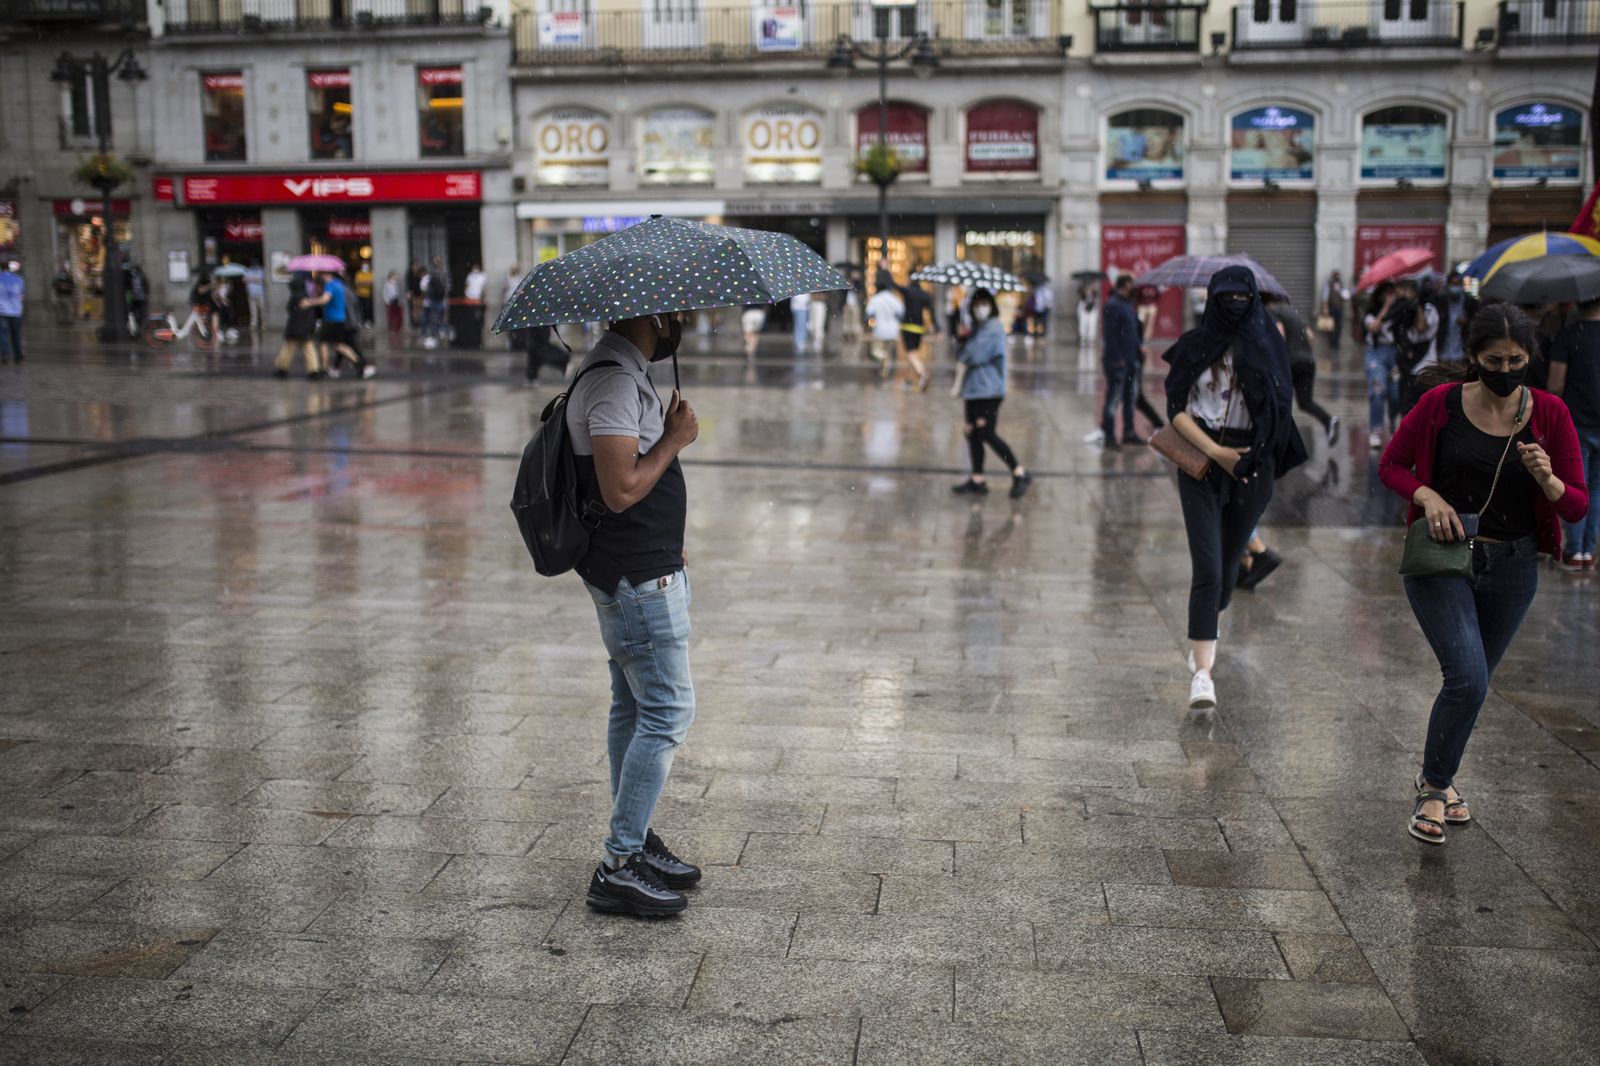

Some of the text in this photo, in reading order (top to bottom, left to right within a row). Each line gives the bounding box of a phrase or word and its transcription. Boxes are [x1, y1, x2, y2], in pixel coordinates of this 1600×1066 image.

[540, 123, 608, 153] ORO
[749, 120, 821, 151] ORO
[283, 177, 373, 198] VIPS
